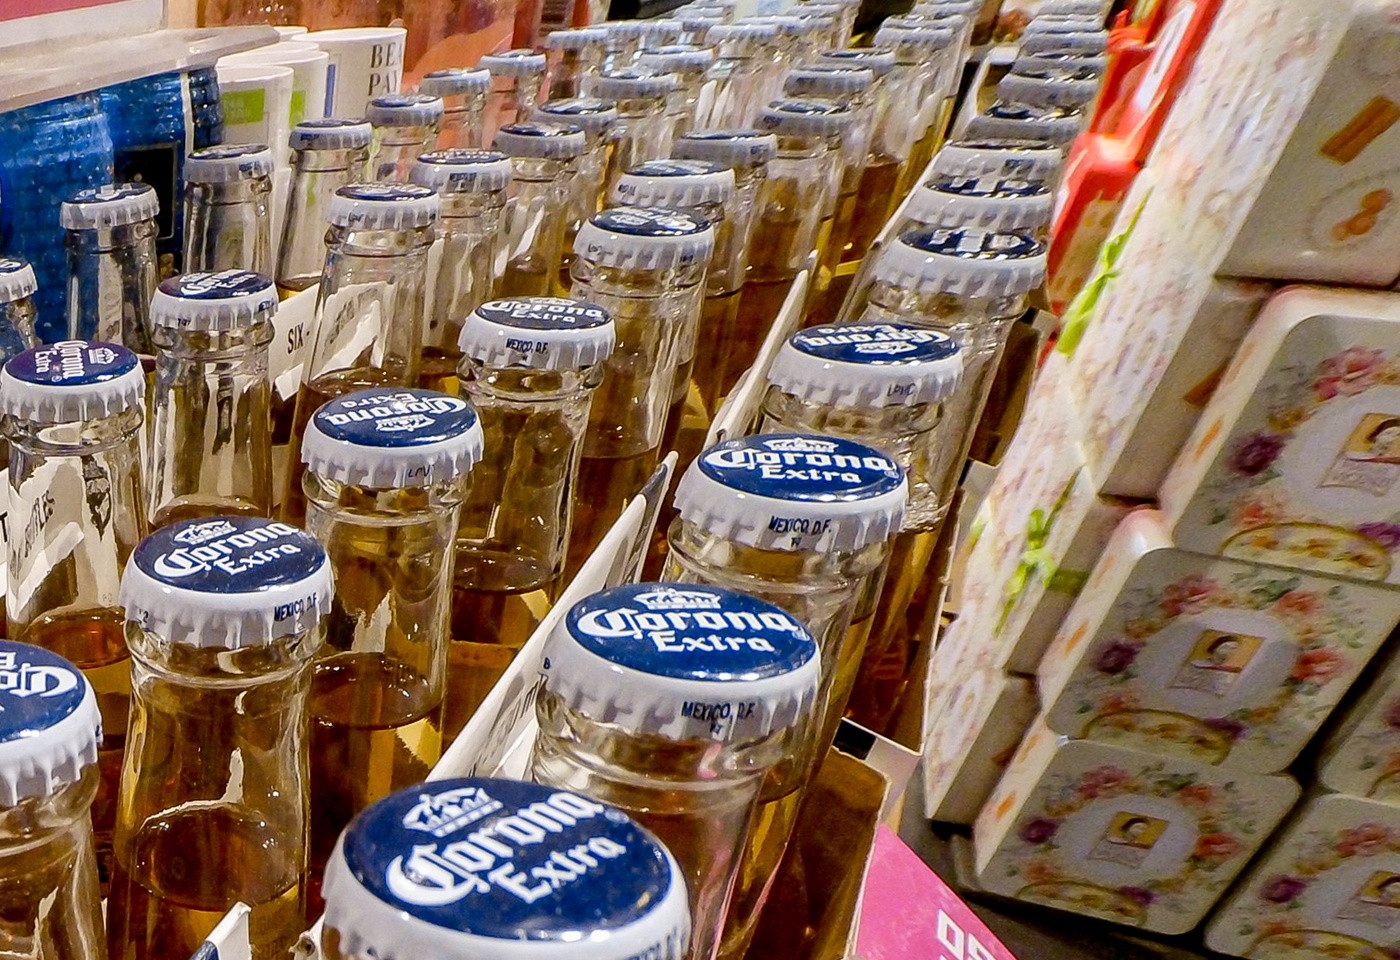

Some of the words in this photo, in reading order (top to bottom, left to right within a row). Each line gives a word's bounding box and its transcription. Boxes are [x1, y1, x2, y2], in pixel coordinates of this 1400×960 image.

[480, 300, 604, 318] Corona
[510, 309, 576, 324] Extra
[287, 322, 304, 355] SIX
[325, 396, 467, 427] Corona
[340, 392, 418, 408] Extra
[703, 448, 898, 472] Corona
[760, 463, 862, 484] Extra
[153, 521, 299, 577] Corona
[214, 542, 302, 576] Extra
[576, 607, 803, 640] Corona
[647, 629, 775, 653] Extra
[385, 791, 604, 907] Corona
[487, 836, 627, 904] Extra
